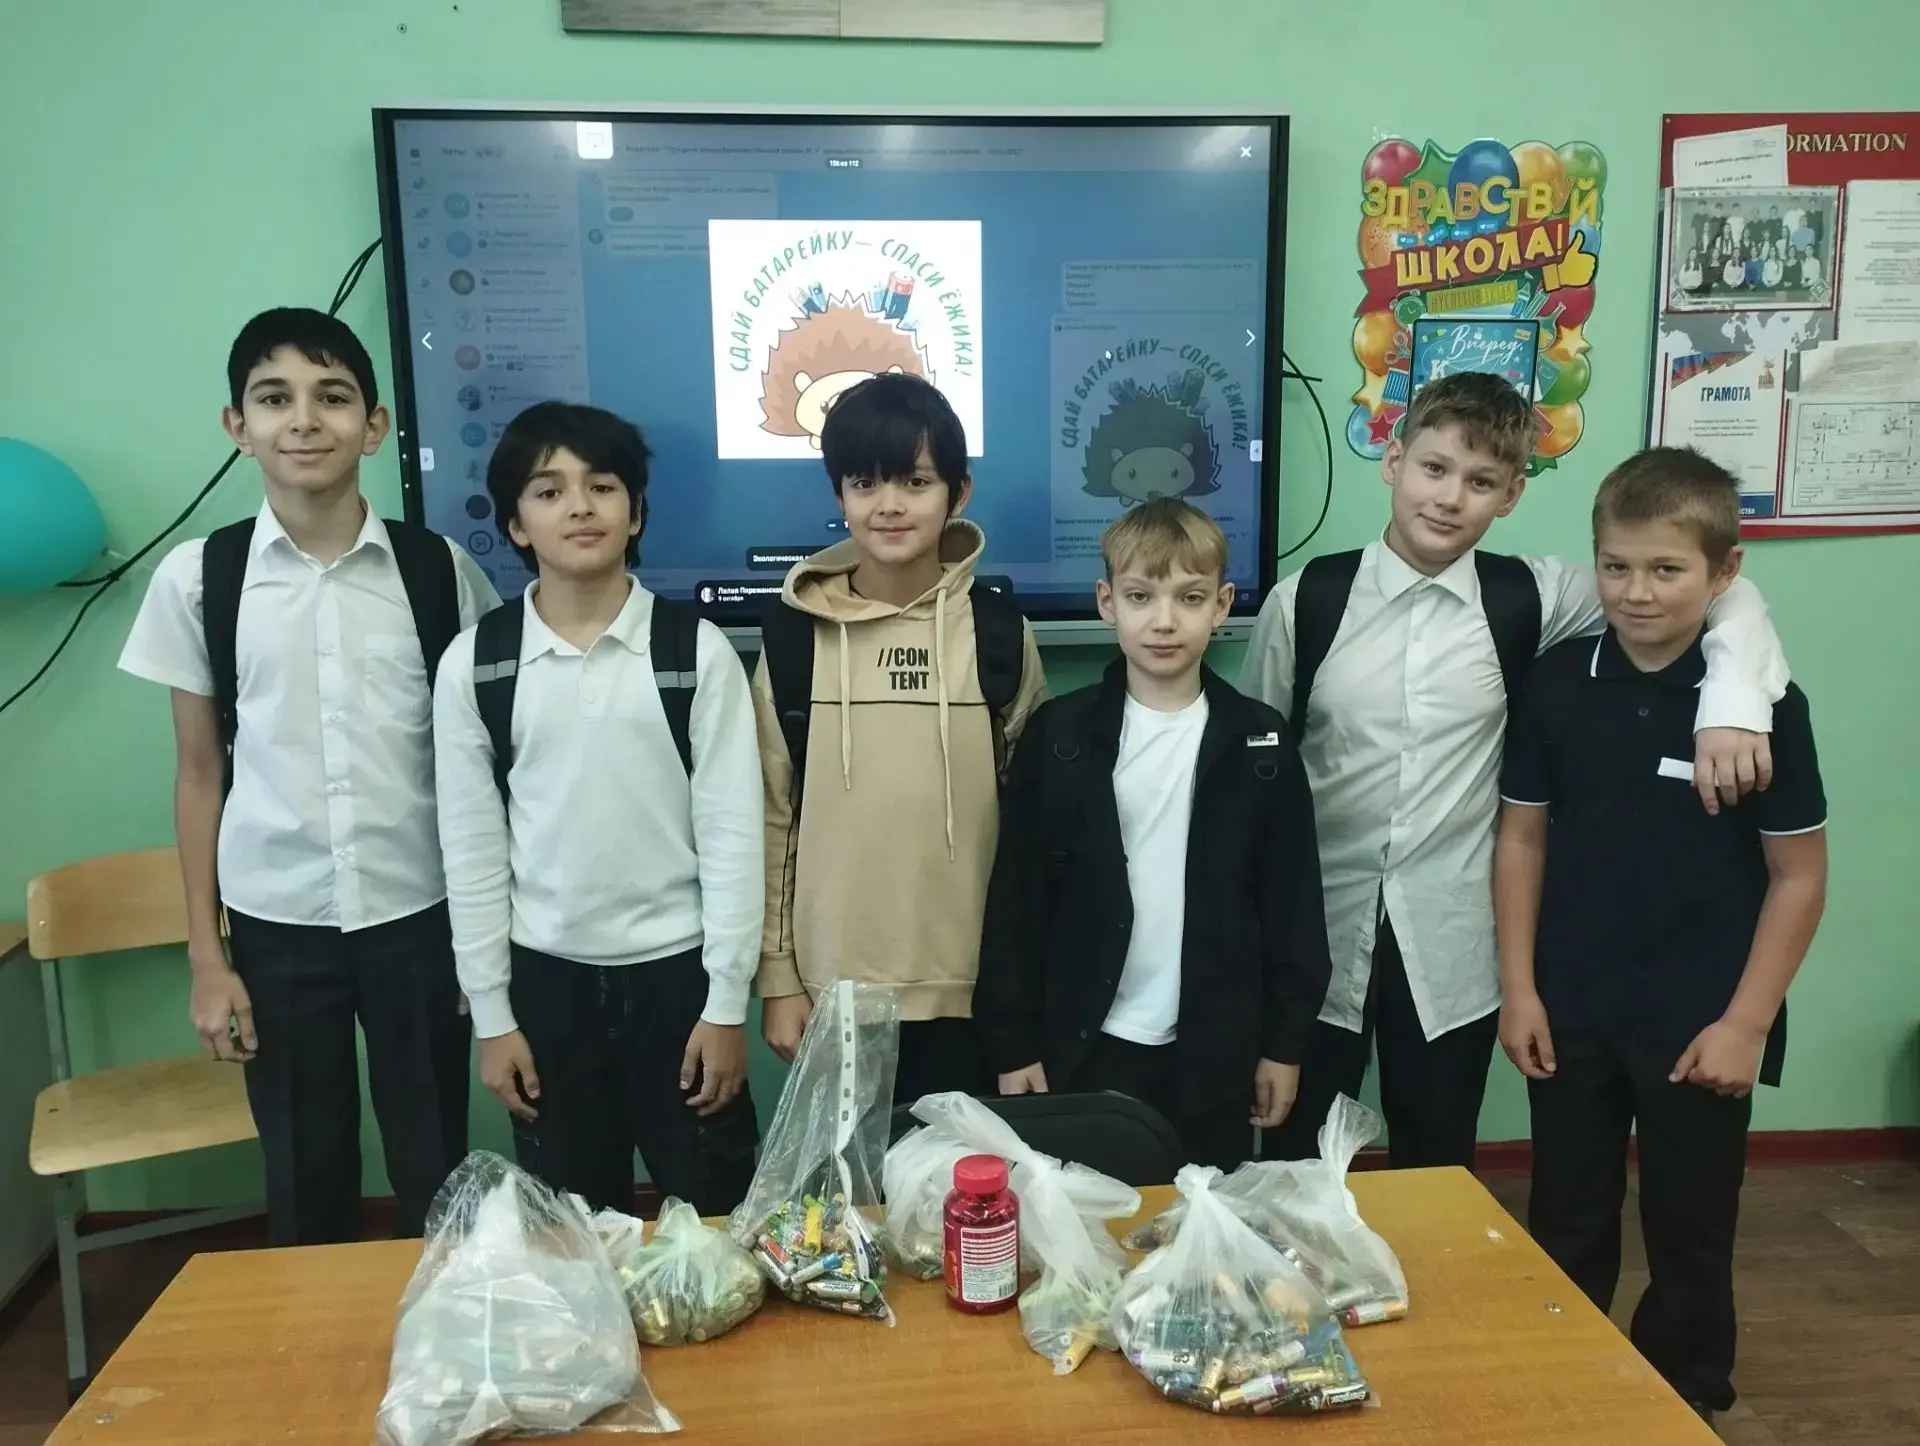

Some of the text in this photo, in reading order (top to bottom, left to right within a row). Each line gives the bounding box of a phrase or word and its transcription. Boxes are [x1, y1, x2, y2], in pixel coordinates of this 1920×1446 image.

[1786, 133, 1908, 152] ORMATION
[1363, 176, 1599, 229] ЗДРАВСТВУЙ
[1396, 224, 1563, 287] ШКОЛА!
[729, 311, 752, 372] СДАЙ
[881, 238, 945, 289] СПАСИ
[938, 288, 973, 377] ЁЖИКА!
[1062, 402, 1082, 448] СДАЙ
[1179, 344, 1228, 383] СПАСИ
[1222, 380, 1249, 450] ЁЖИКА!
[1700, 386, 1751, 402] ГРАМОТА
[889, 671, 929, 690] TENT
